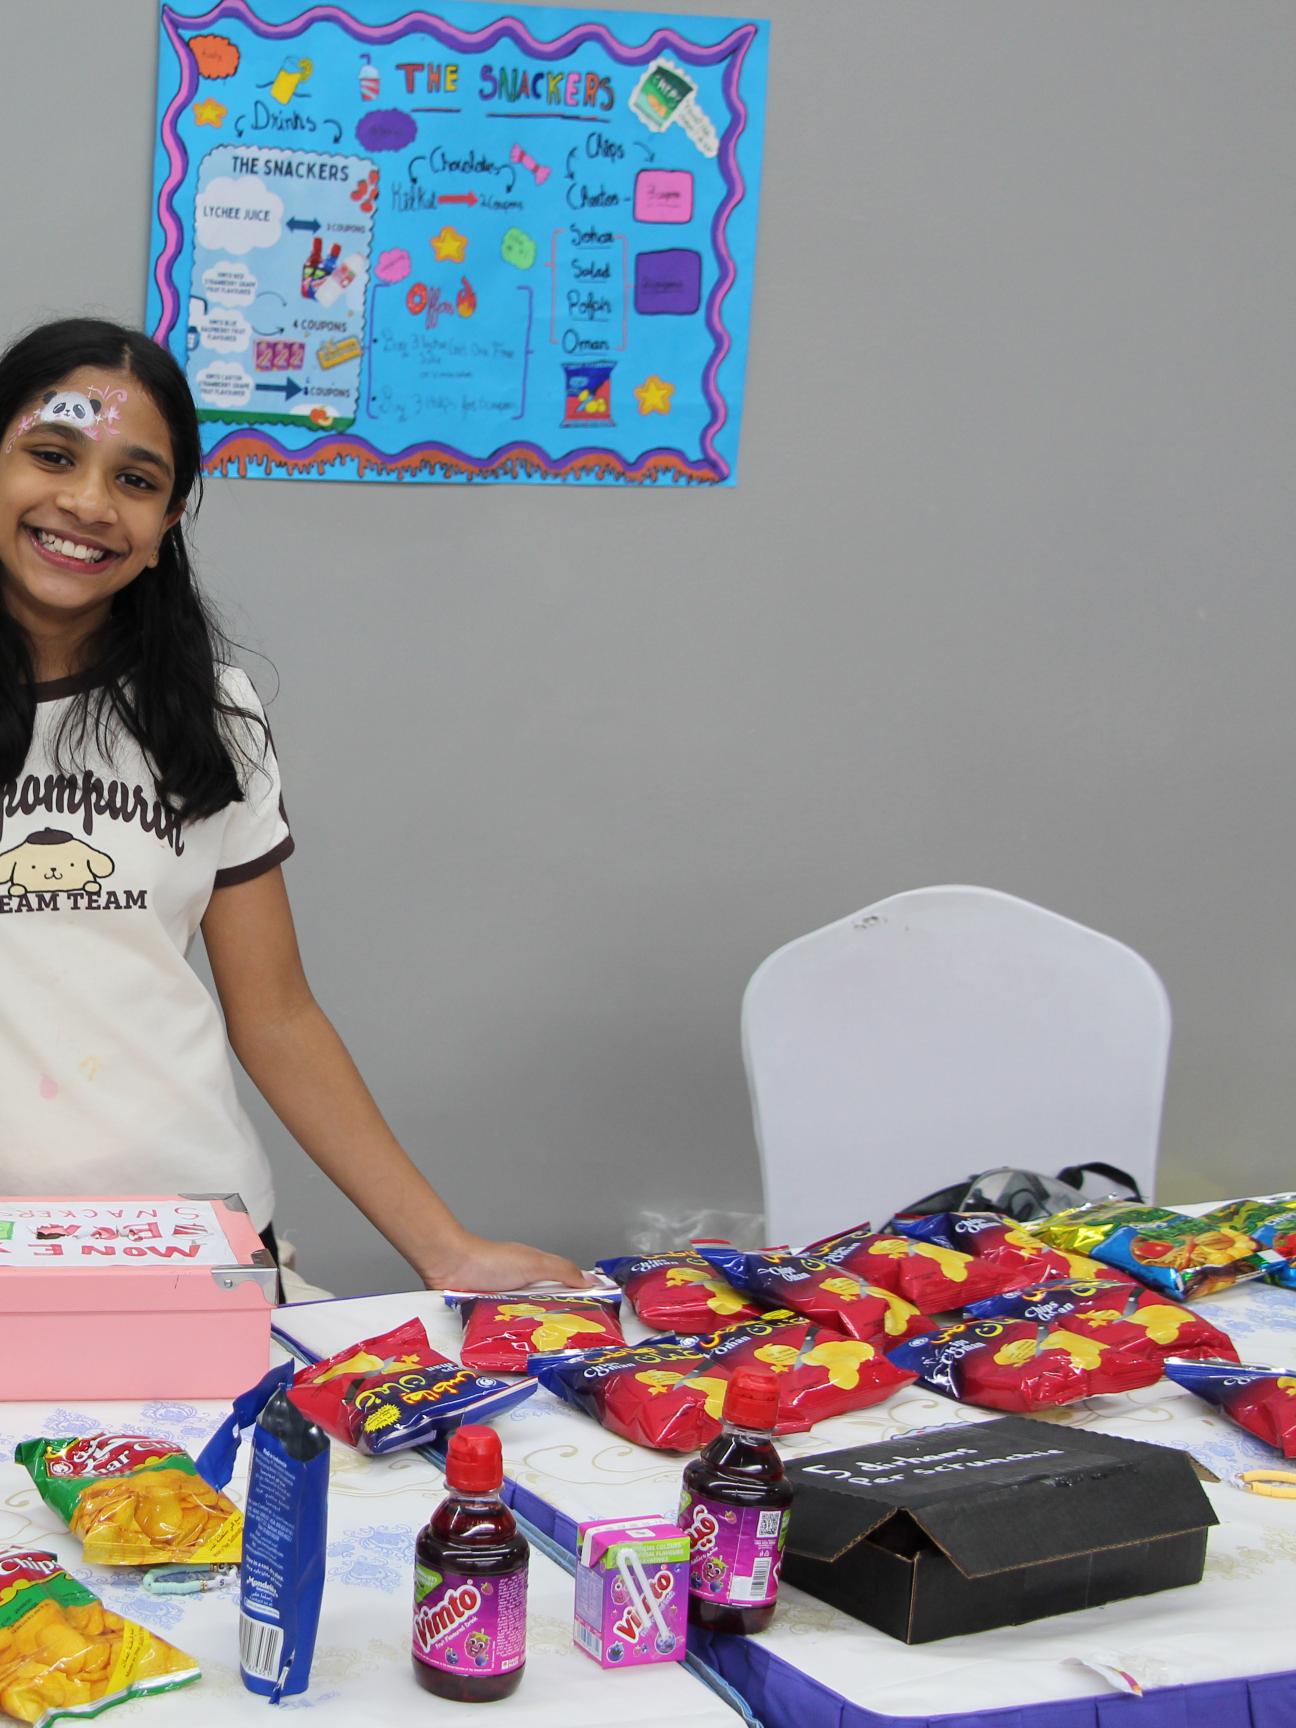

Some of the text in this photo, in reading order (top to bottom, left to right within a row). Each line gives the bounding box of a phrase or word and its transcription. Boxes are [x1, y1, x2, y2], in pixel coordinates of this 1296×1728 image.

[395, 63, 615, 111] THE SNACKERS
[252, 100, 317, 132] Drinks
[232, 156, 350, 181] THE SNACKERS
[203, 206, 271, 221] LYCHEE JUICE
[301, 320, 347, 333] COUPONS
[310, 388, 350, 397] COUPONS
[67, 889, 148, 910] TEAM
[802, 1447, 978, 1479] 5 dirhams
[848, 1448, 1064, 1486] Per scrunchie
[415, 1588, 478, 1650] Vimto
